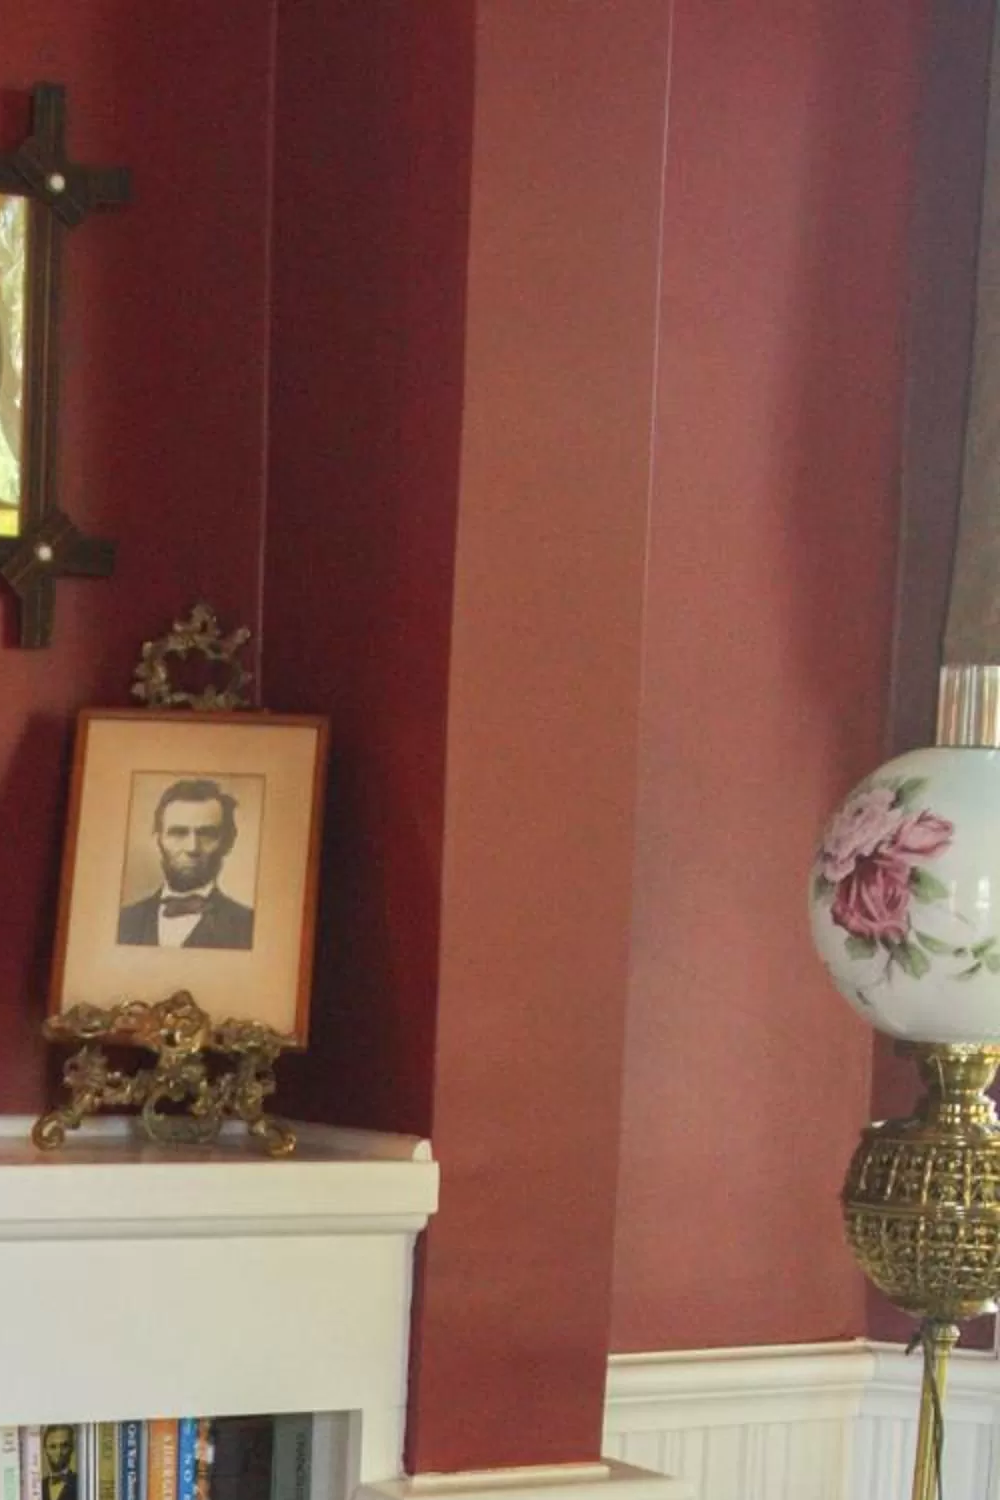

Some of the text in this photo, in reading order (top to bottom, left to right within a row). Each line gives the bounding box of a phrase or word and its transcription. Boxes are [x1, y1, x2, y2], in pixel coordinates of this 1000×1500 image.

[126, 1424, 138, 1447] Civil
[126, 1449, 138, 1469] War
[183, 1452, 193, 1482] NO
